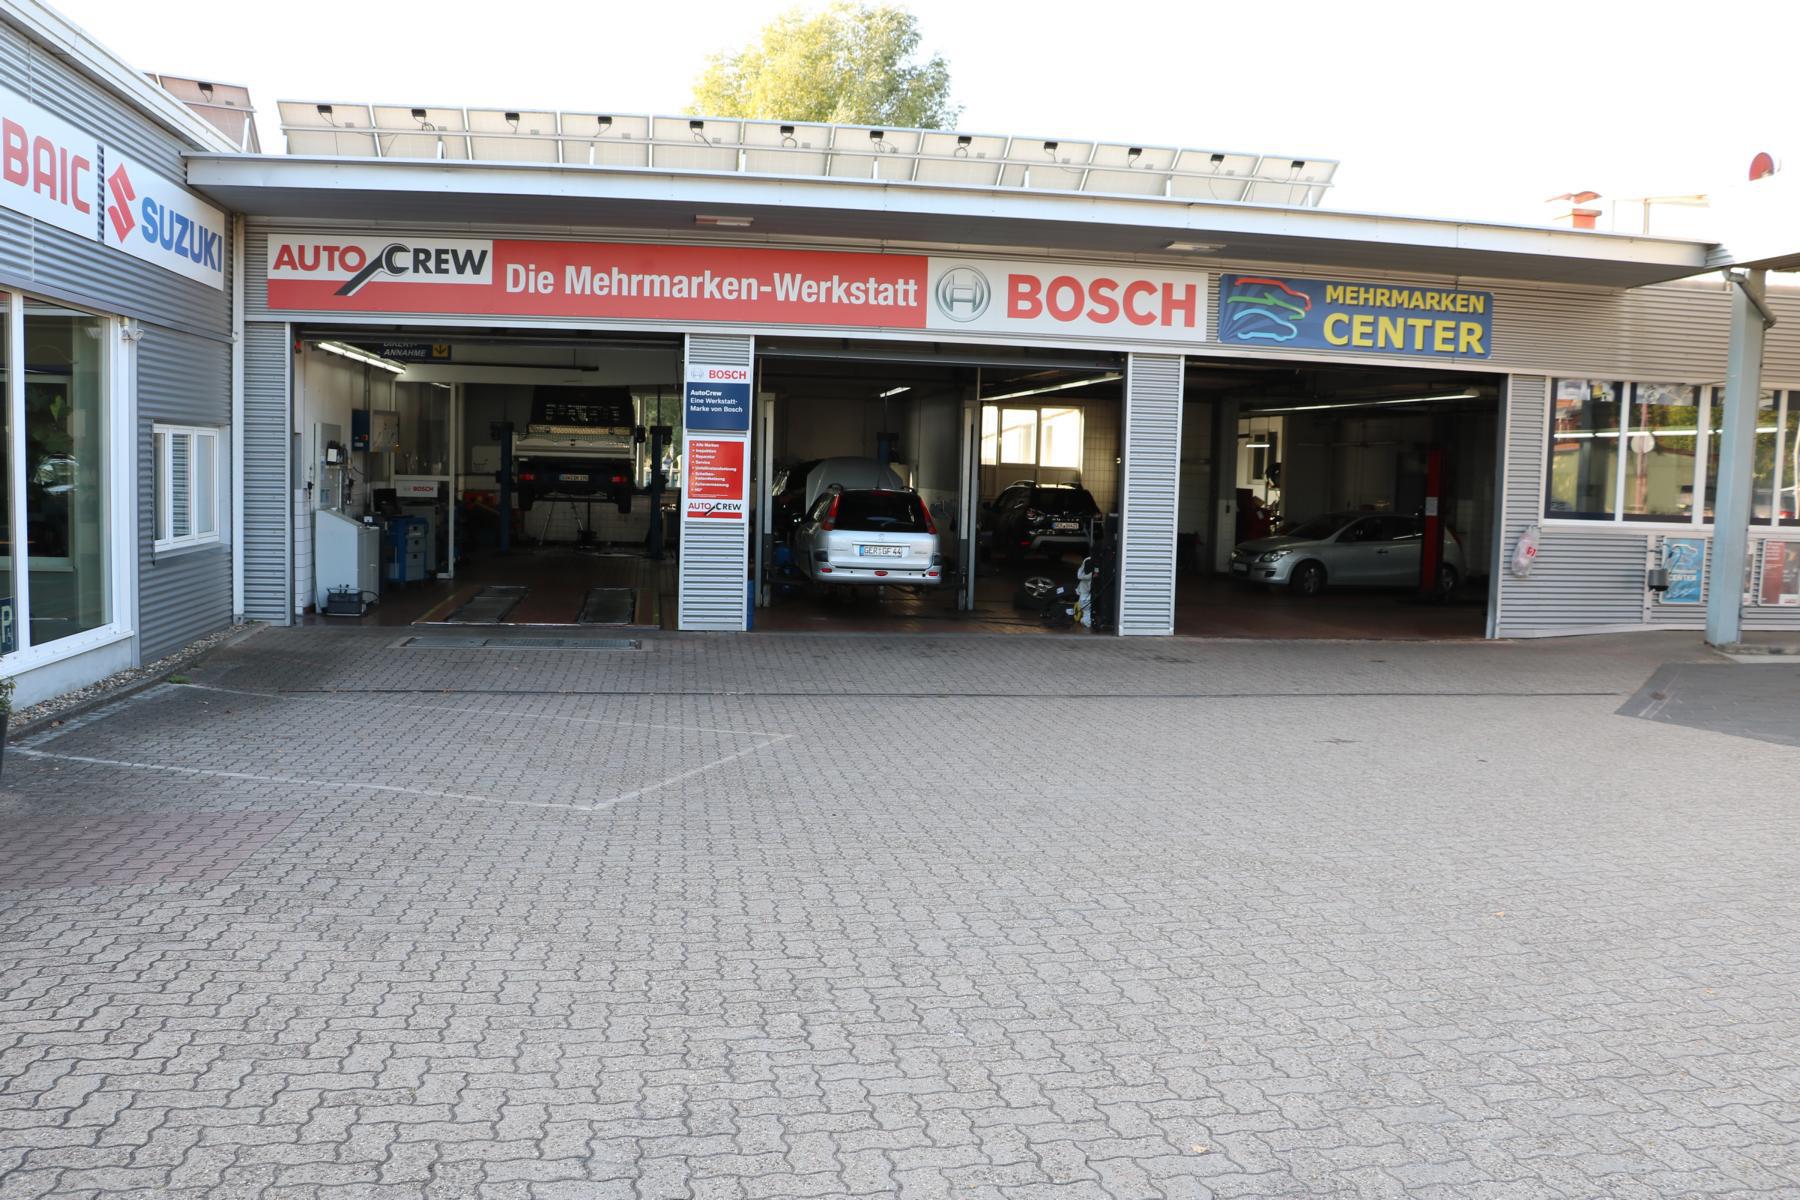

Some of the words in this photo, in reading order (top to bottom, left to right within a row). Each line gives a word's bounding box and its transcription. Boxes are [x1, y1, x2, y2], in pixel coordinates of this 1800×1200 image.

[2, 117, 91, 215] BAIC
[141, 196, 223, 273] SUZUKI
[273, 244, 367, 272] AUTO
[382, 243, 488, 277] CREW
[505, 263, 554, 294] Die
[564, 265, 918, 307] Mehrmarken-Werkstatt
[1007, 273, 1197, 328] BOSCH
[1326, 284, 1485, 313] MEHRMARKEN
[1323, 312, 1486, 354] CENTER
[383, 349, 427, 357] ANNAHME
[708, 370, 747, 380] BOSCH
[715, 503, 742, 511] CREW
[864, 546, 878, 555] GER
[882, 547, 891, 556] GF
[892, 548, 902, 556] 44
